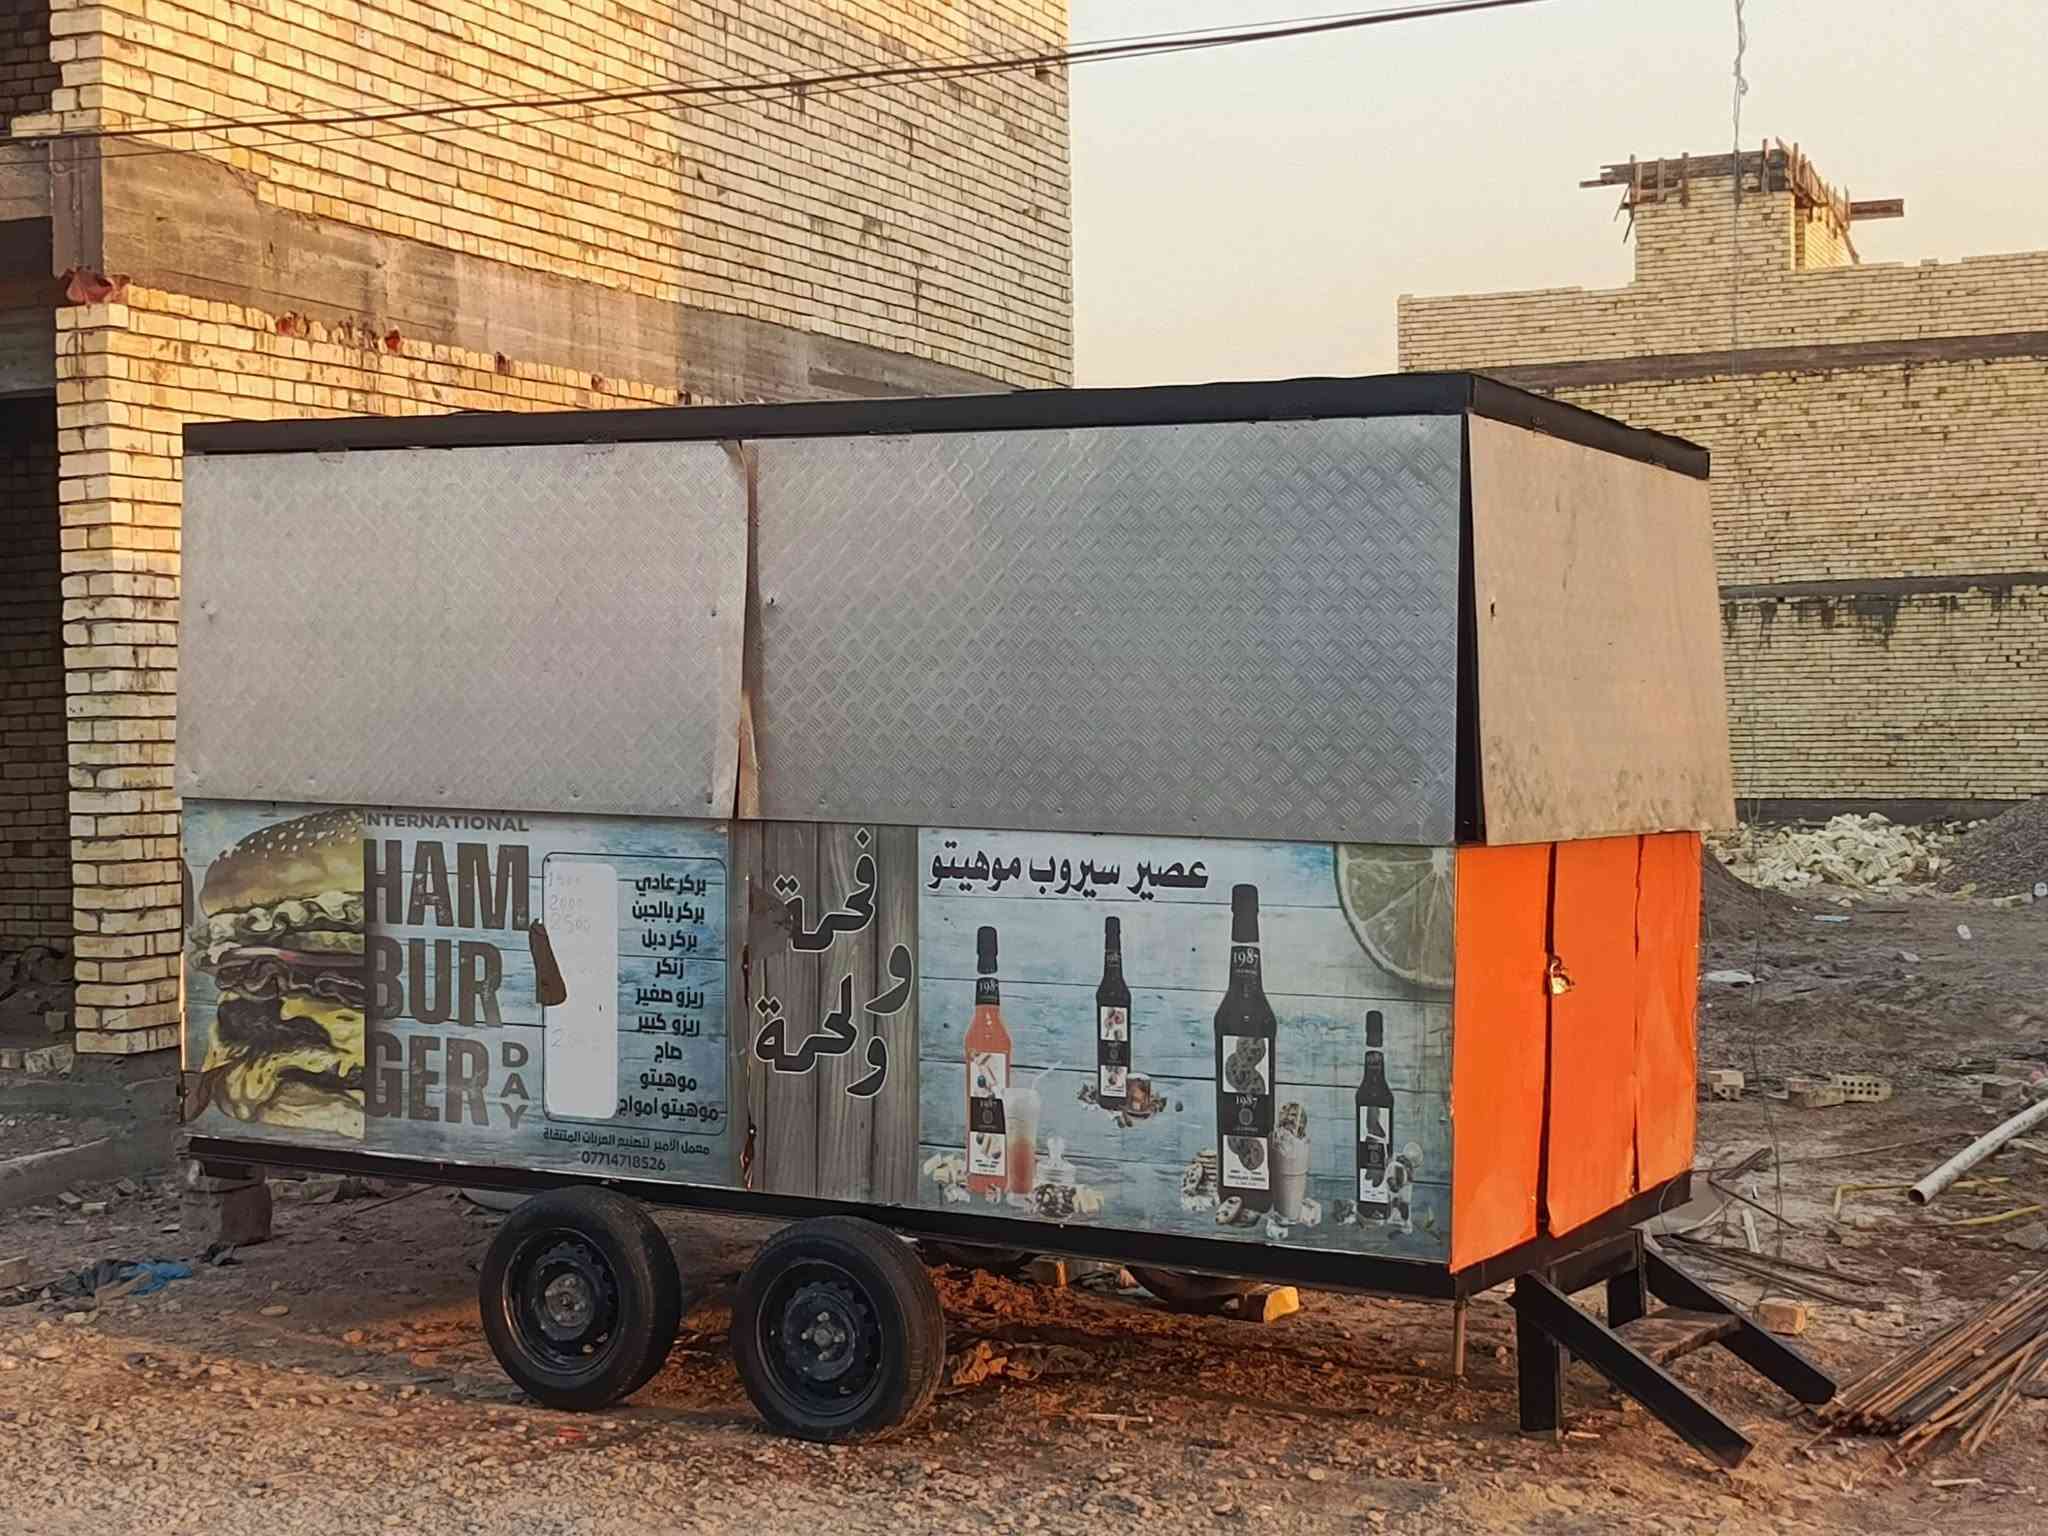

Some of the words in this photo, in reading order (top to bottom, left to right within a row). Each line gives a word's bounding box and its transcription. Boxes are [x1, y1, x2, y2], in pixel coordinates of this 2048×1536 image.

[363, 812, 530, 832] INTERNATIONAL
[927, 840, 1022, 892] موهيتو
[1028, 855, 1121, 899] سيروب
[364, 838, 530, 931] HAM
[635, 872, 675, 897] عادي
[676, 873, 706, 897] بركر
[1126, 858, 1209, 901] عصير
[632, 900, 674, 923] بالجبن
[675, 901, 705, 925] بركر
[641, 927, 667, 951] دبل
[668, 929, 698, 953] بركر
[364, 935, 503, 1028] BUR
[634, 983, 673, 1006] صغير
[675, 986, 704, 1009] ريزو
[637, 1012, 667, 1035] كبير
[671, 1014, 700, 1037] ريزو
[654, 1041, 683, 1064] صاج
[364, 1030, 490, 1127] GER
[639, 1068, 698, 1093] موهيتو
[618, 1095, 658, 1117] امواج
[661, 1098, 719, 1122] موهيتو
[681, 1140, 710, 1155] معمل
[580, 1150, 667, 1171] 07714718526
